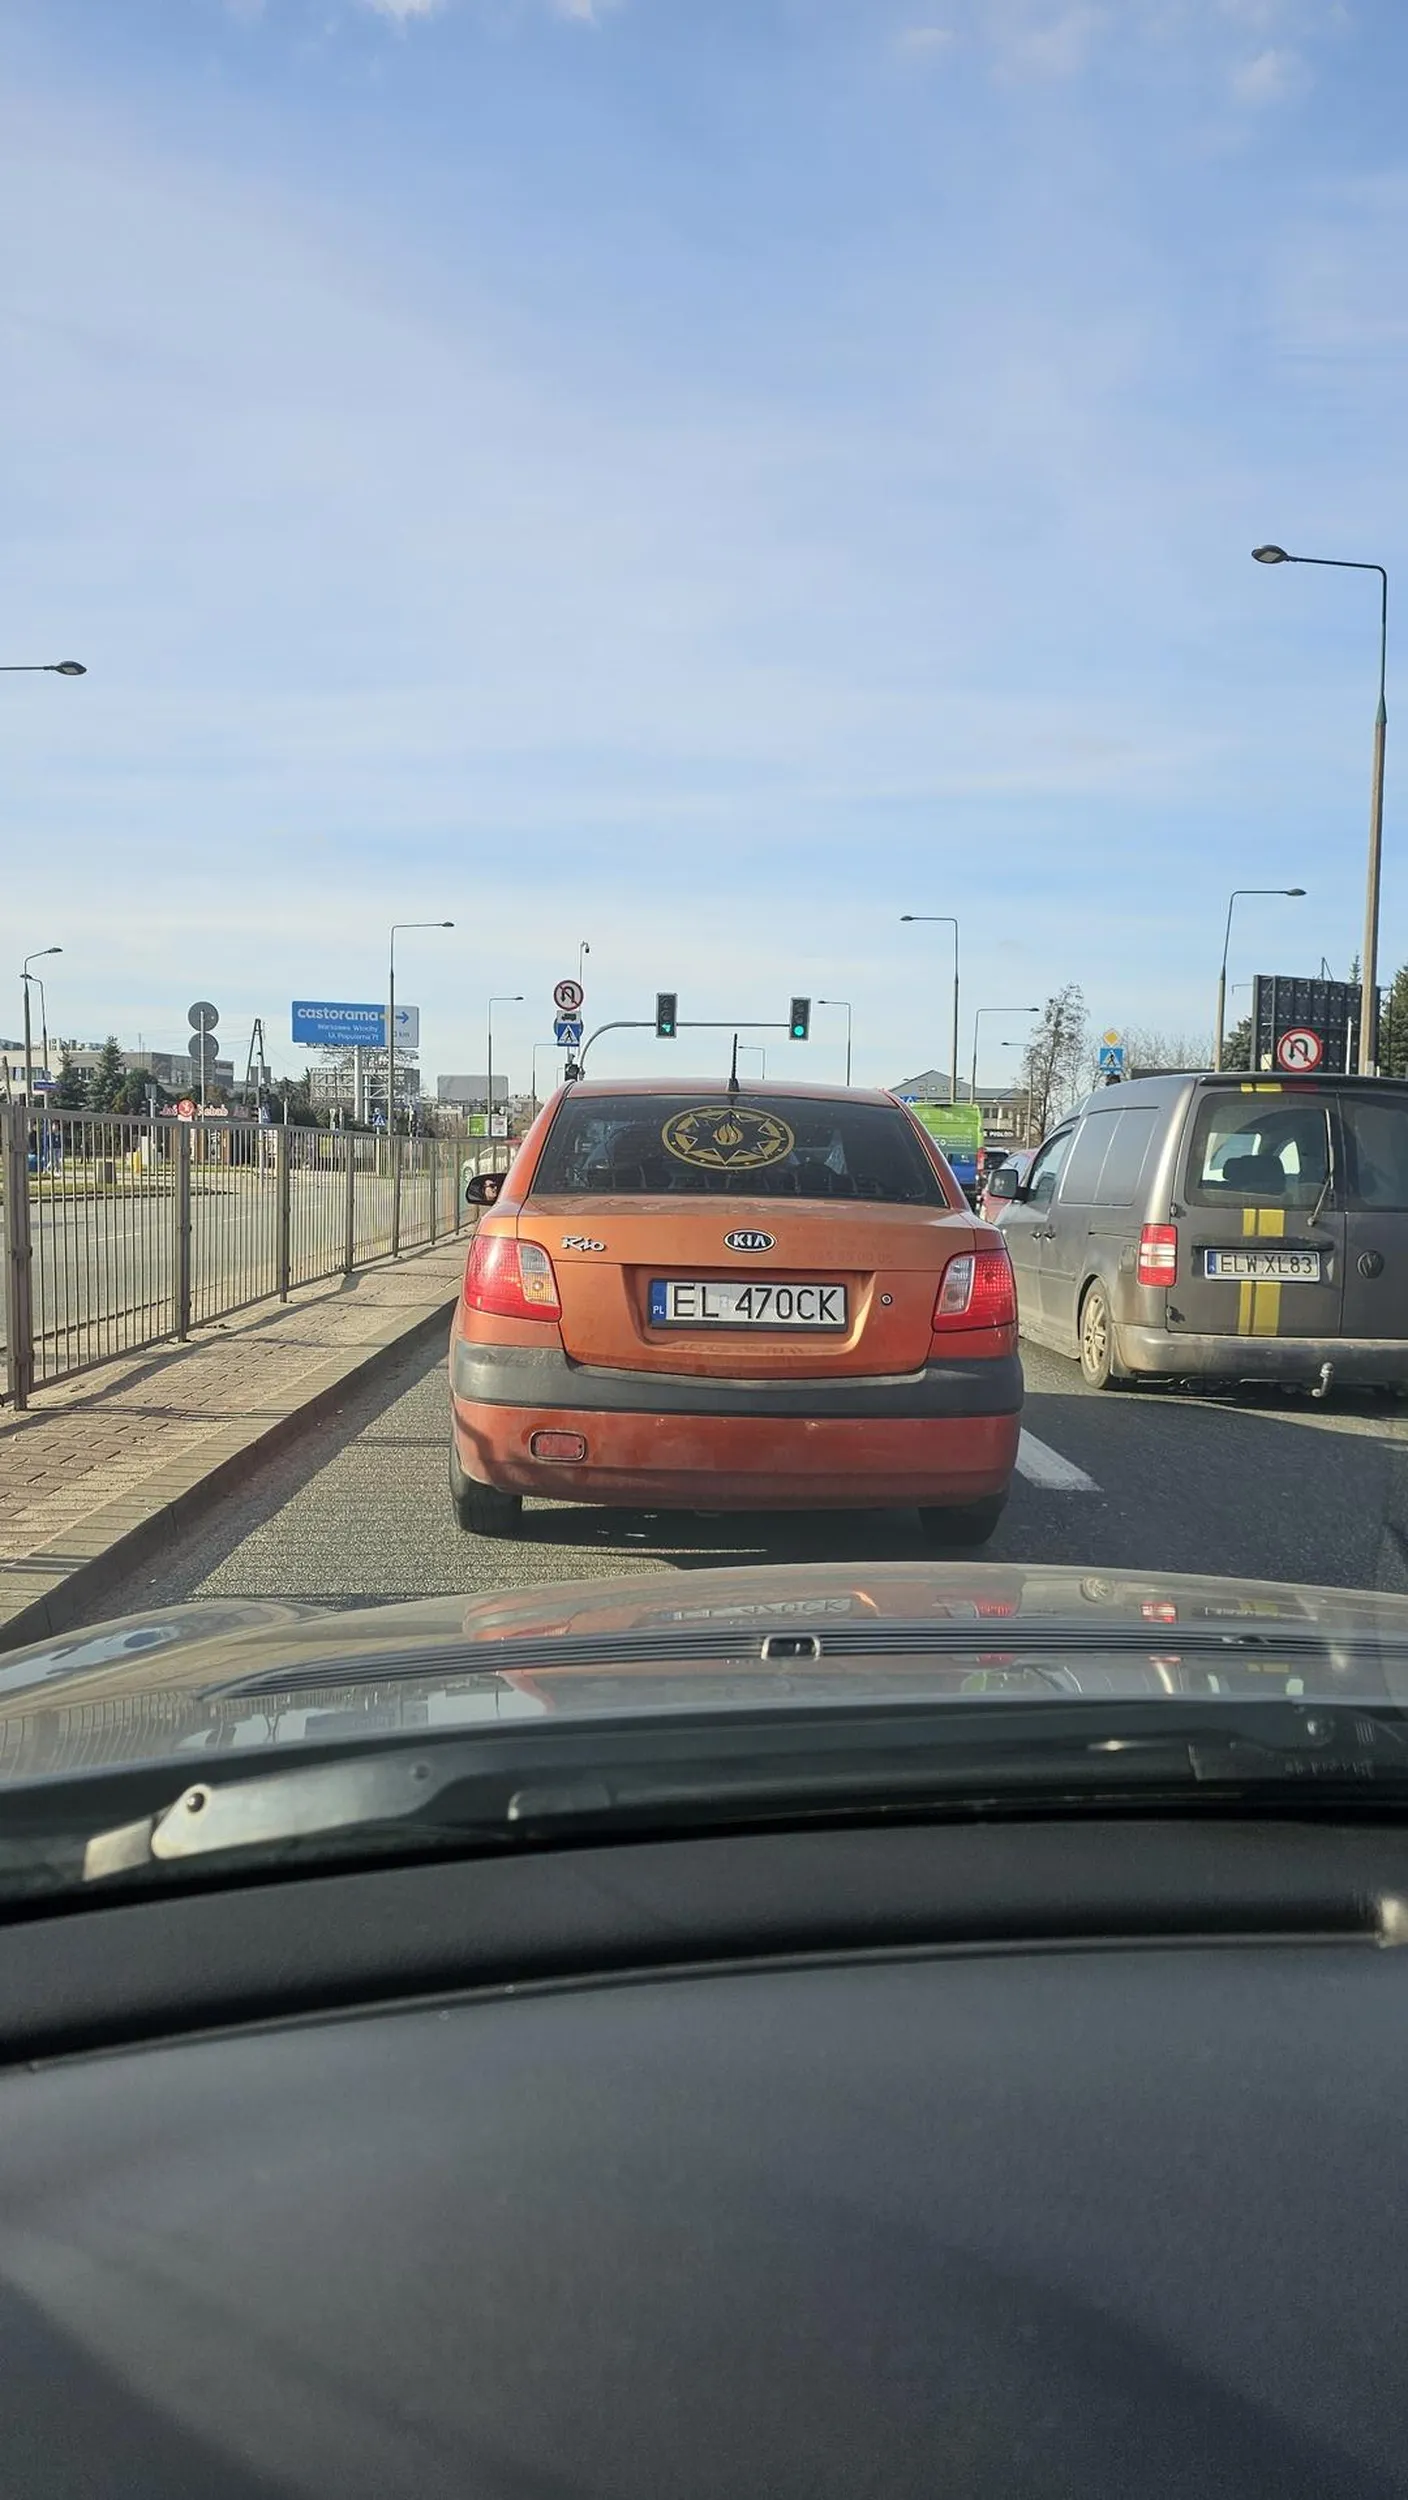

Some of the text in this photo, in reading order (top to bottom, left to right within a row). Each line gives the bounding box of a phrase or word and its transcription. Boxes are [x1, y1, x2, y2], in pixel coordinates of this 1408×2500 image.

[297, 1007, 379, 1021] castorama
[561, 1235, 605, 1251] Rio
[733, 1234, 767, 1247] KIA
[1221, 1254, 1313, 1274] ELW XL83
[653, 1306, 665, 1315] PL
[673, 1285, 837, 1321] EL 470CK
